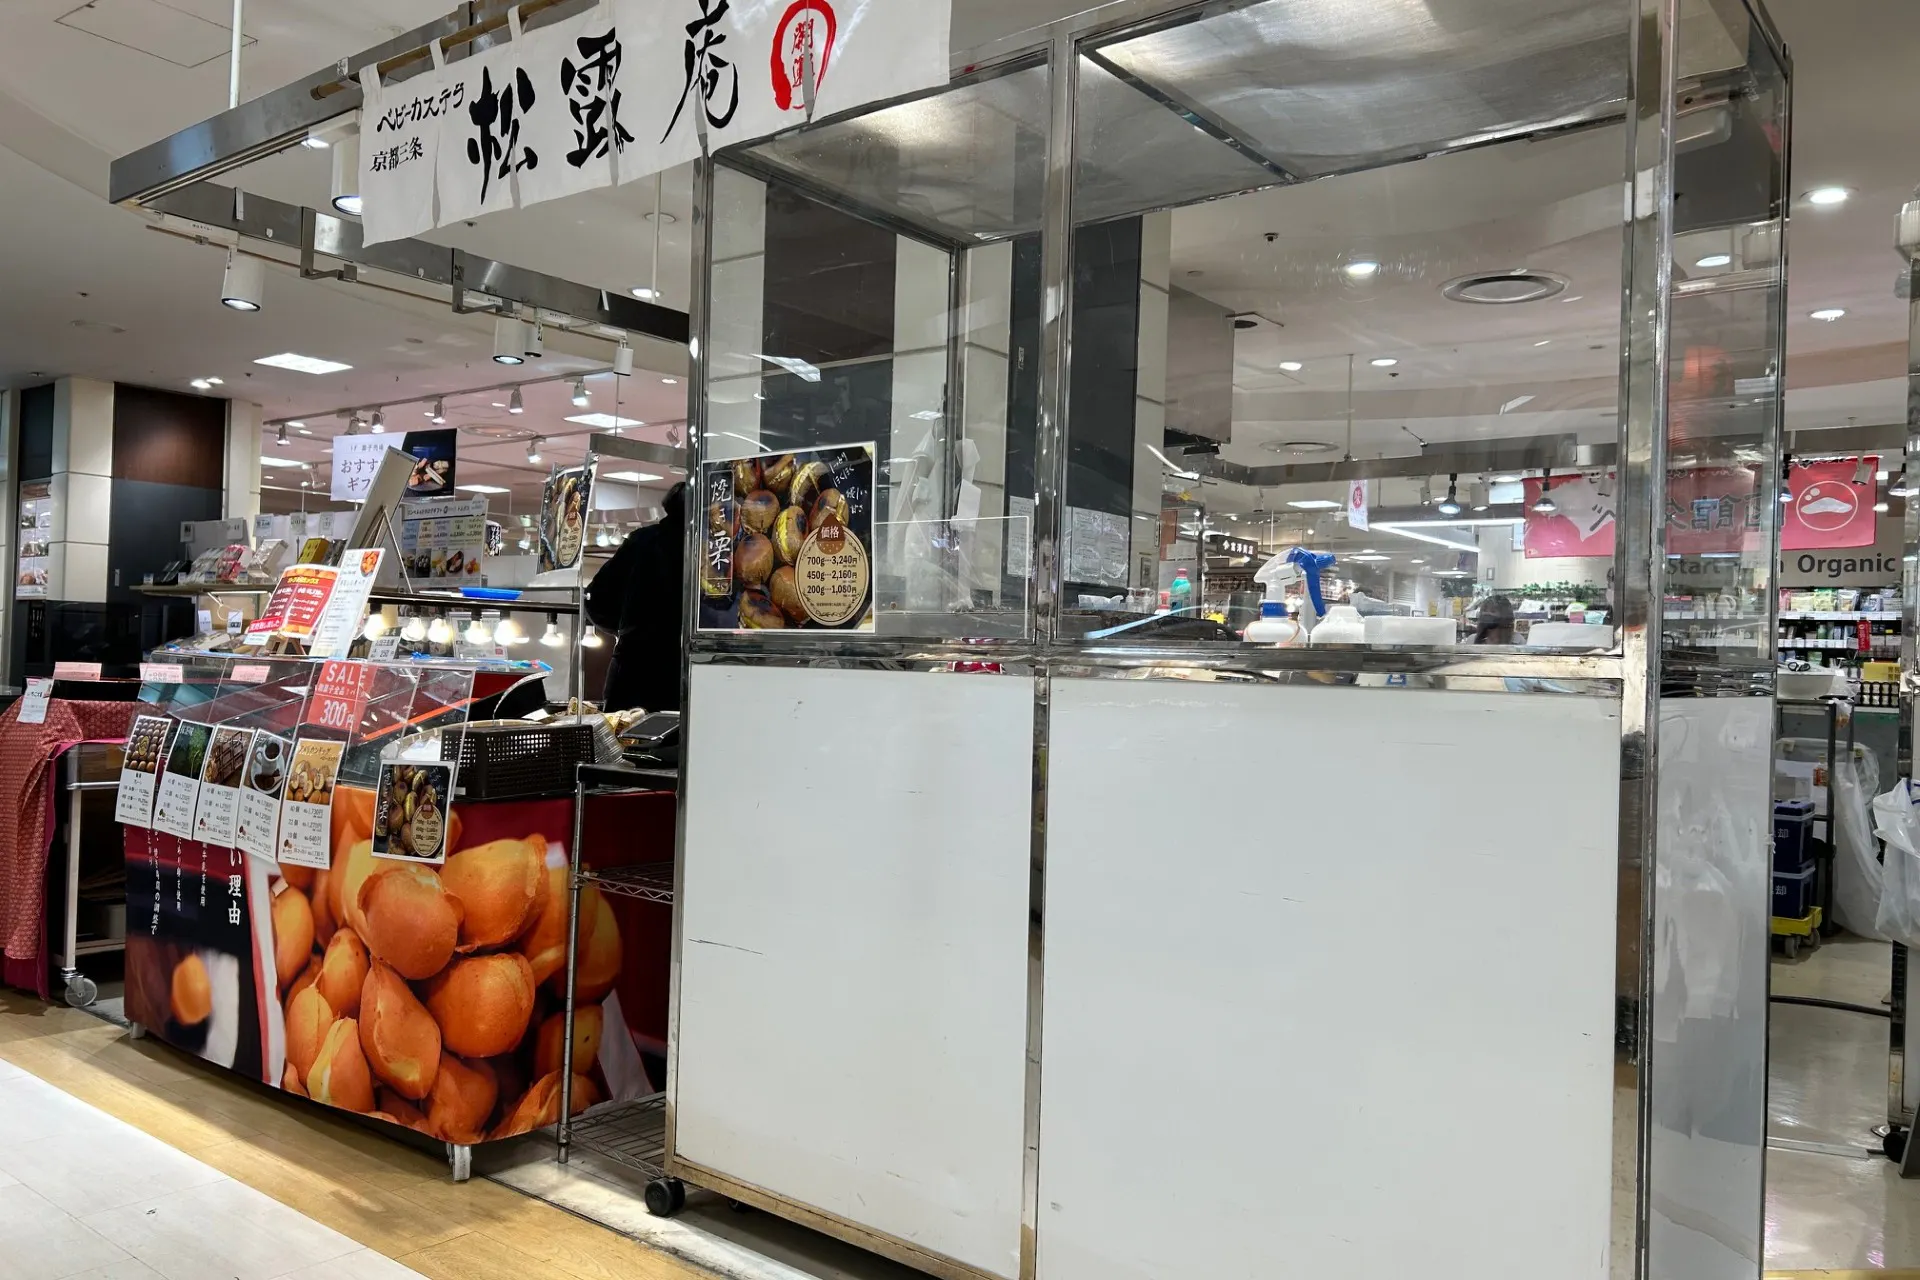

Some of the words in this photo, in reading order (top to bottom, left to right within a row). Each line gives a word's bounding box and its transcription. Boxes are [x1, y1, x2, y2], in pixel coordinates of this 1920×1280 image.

[376, 82, 464, 133] ベビーカステラ
[467, 0, 738, 205] 松露庵
[370, 136, 423, 173] 京都三条
[340, 458, 381, 473] おすす
[348, 477, 371, 491] ギフ
[709, 478, 731, 571] 焼き栗
[821, 527, 840, 538] 価格
[1798, 554, 1896, 577] Organic
[319, 700, 356, 730] 300円
